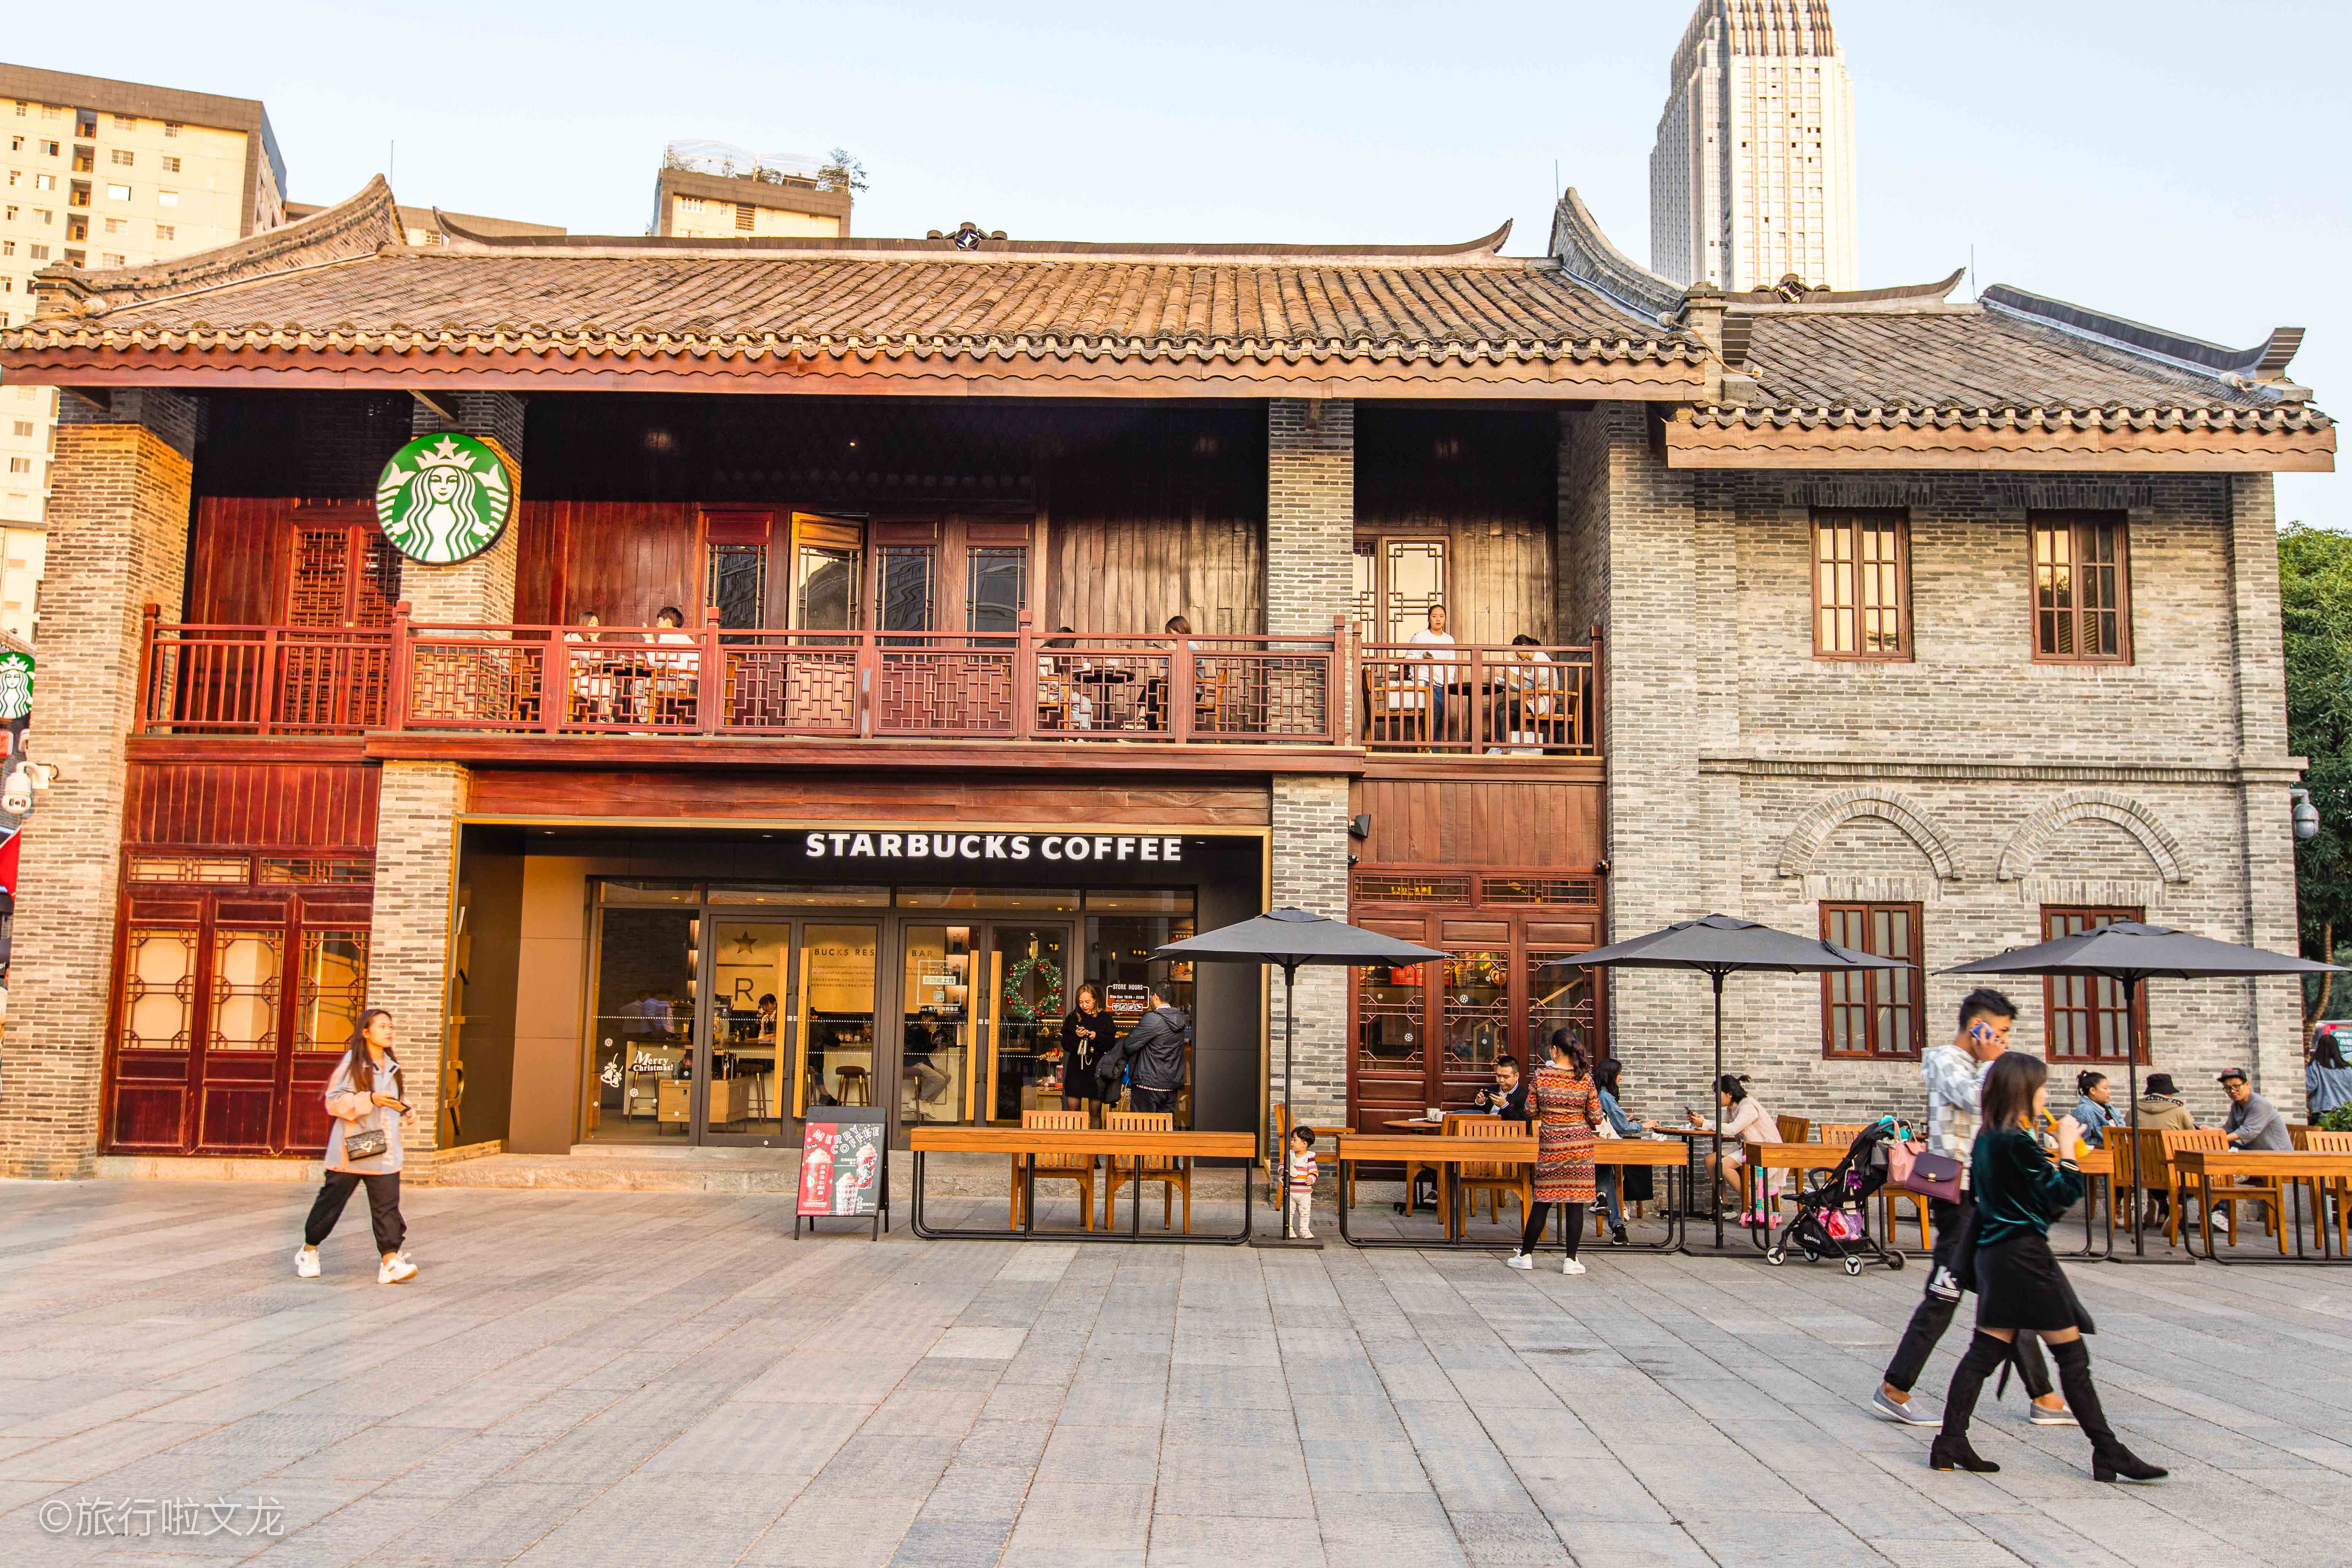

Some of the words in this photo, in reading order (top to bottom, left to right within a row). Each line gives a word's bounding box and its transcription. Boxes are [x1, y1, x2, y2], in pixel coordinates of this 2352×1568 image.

[806, 833, 1030, 859] STARBUCKS
[1042, 836, 1181, 861] COFFEE
[735, 978, 754, 1002] R
[633, 1050, 669, 1066] Merry
[812, 1124, 859, 1144] MERRY
[830, 1127, 879, 1154] COFFEE
